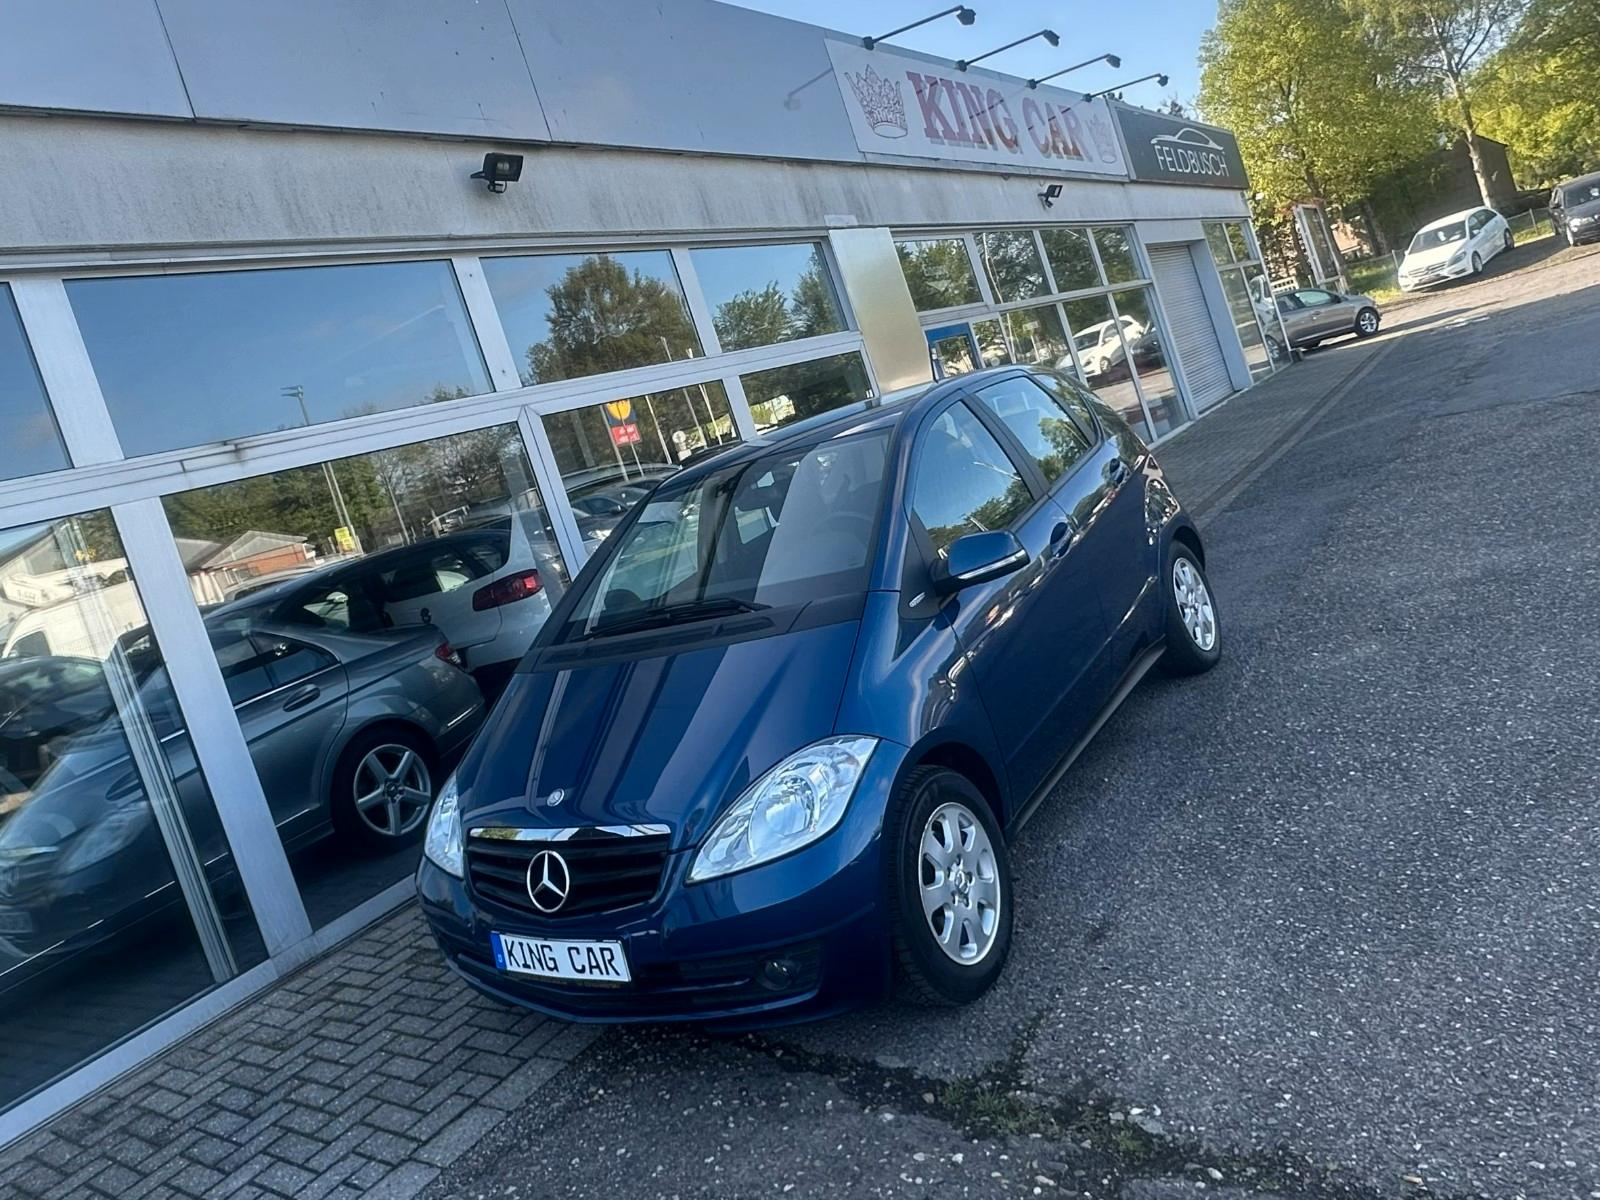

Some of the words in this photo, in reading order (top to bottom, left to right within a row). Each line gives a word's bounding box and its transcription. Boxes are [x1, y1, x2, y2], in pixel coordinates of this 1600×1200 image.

[905, 70, 1020, 152] KING
[1022, 96, 1091, 160] CAR
[1154, 144, 1230, 177] FELDBUSCH
[503, 937, 560, 973] KING
[566, 946, 621, 977] CAR
